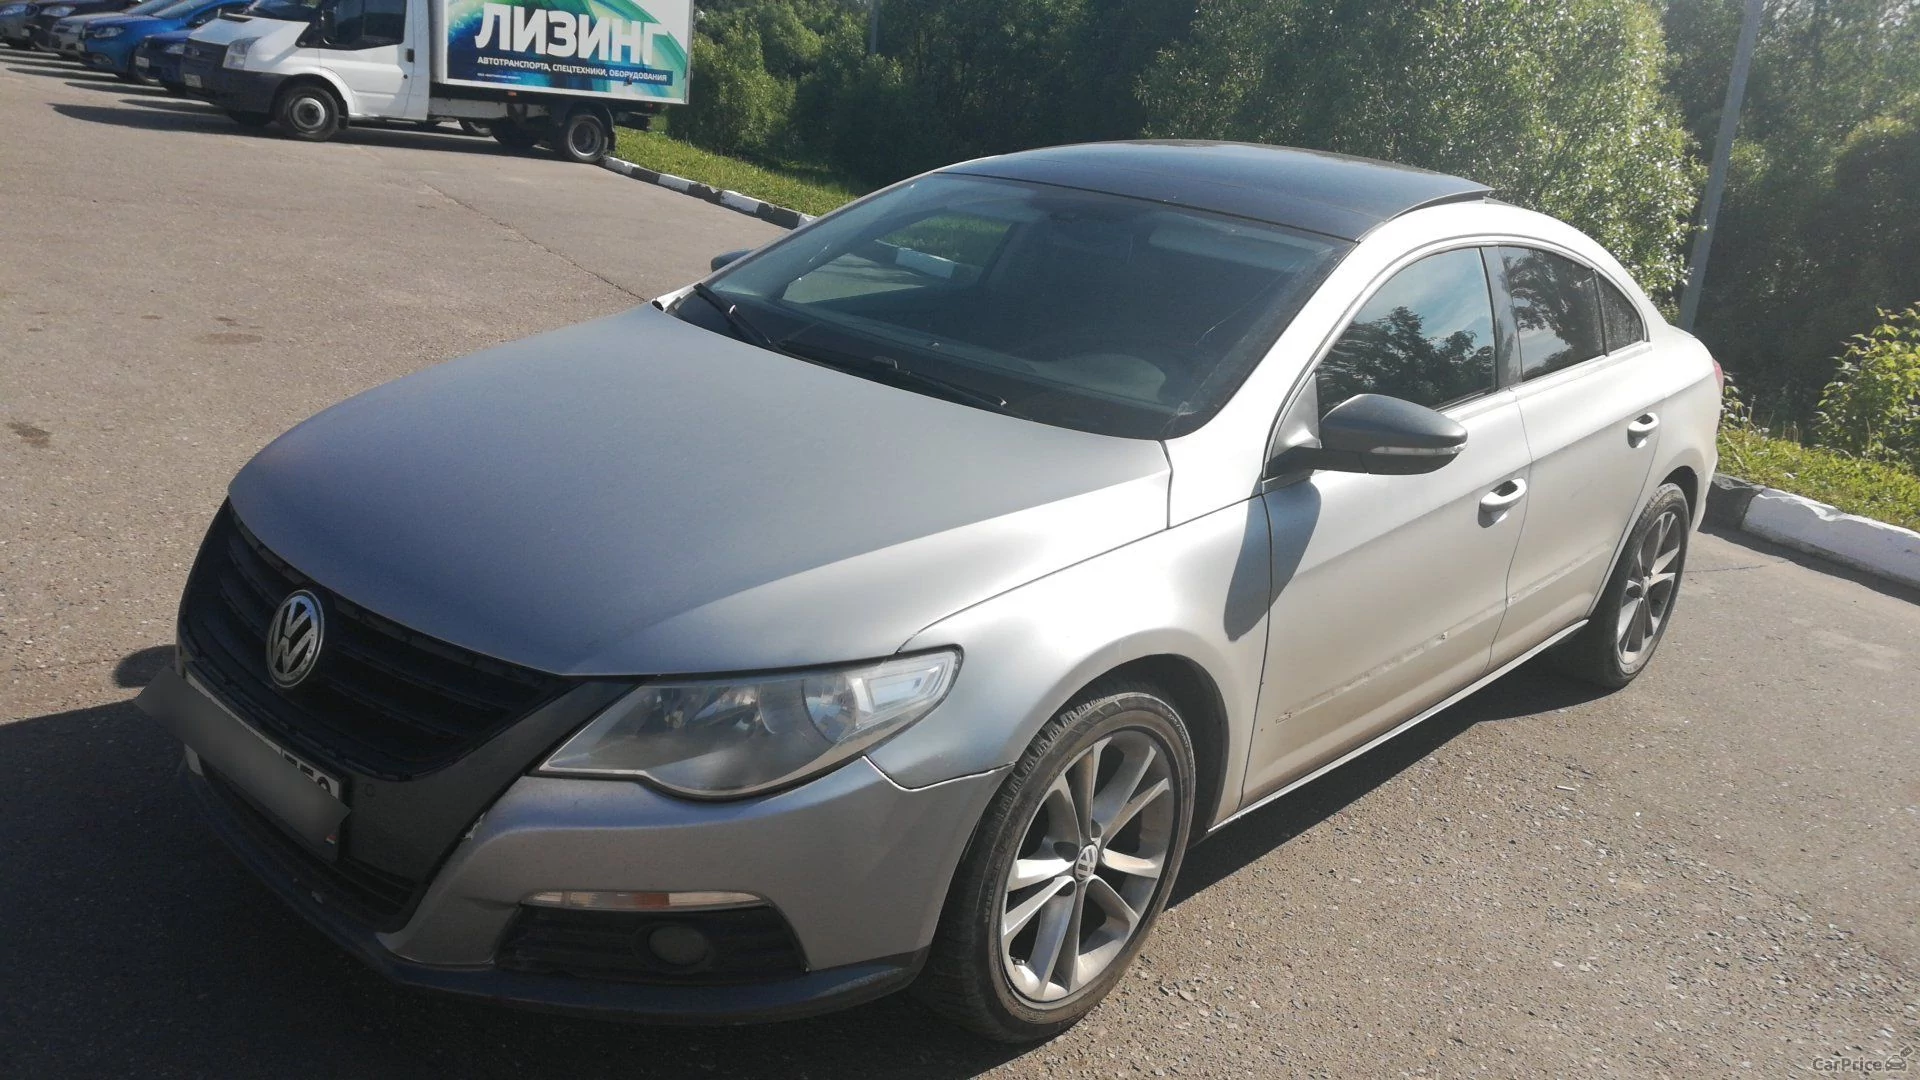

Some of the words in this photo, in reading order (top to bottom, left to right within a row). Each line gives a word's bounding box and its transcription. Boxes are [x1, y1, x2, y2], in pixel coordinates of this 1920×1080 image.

[475, 3, 665, 66] ЛИЗИНГ
[477, 56, 551, 72] АВТОТРАНСПОРТА,
[552, 64, 608, 78] СПЕЦТЕХНИКИ,
[609, 69, 668, 82] ОБОРУДОВАНИЯ
